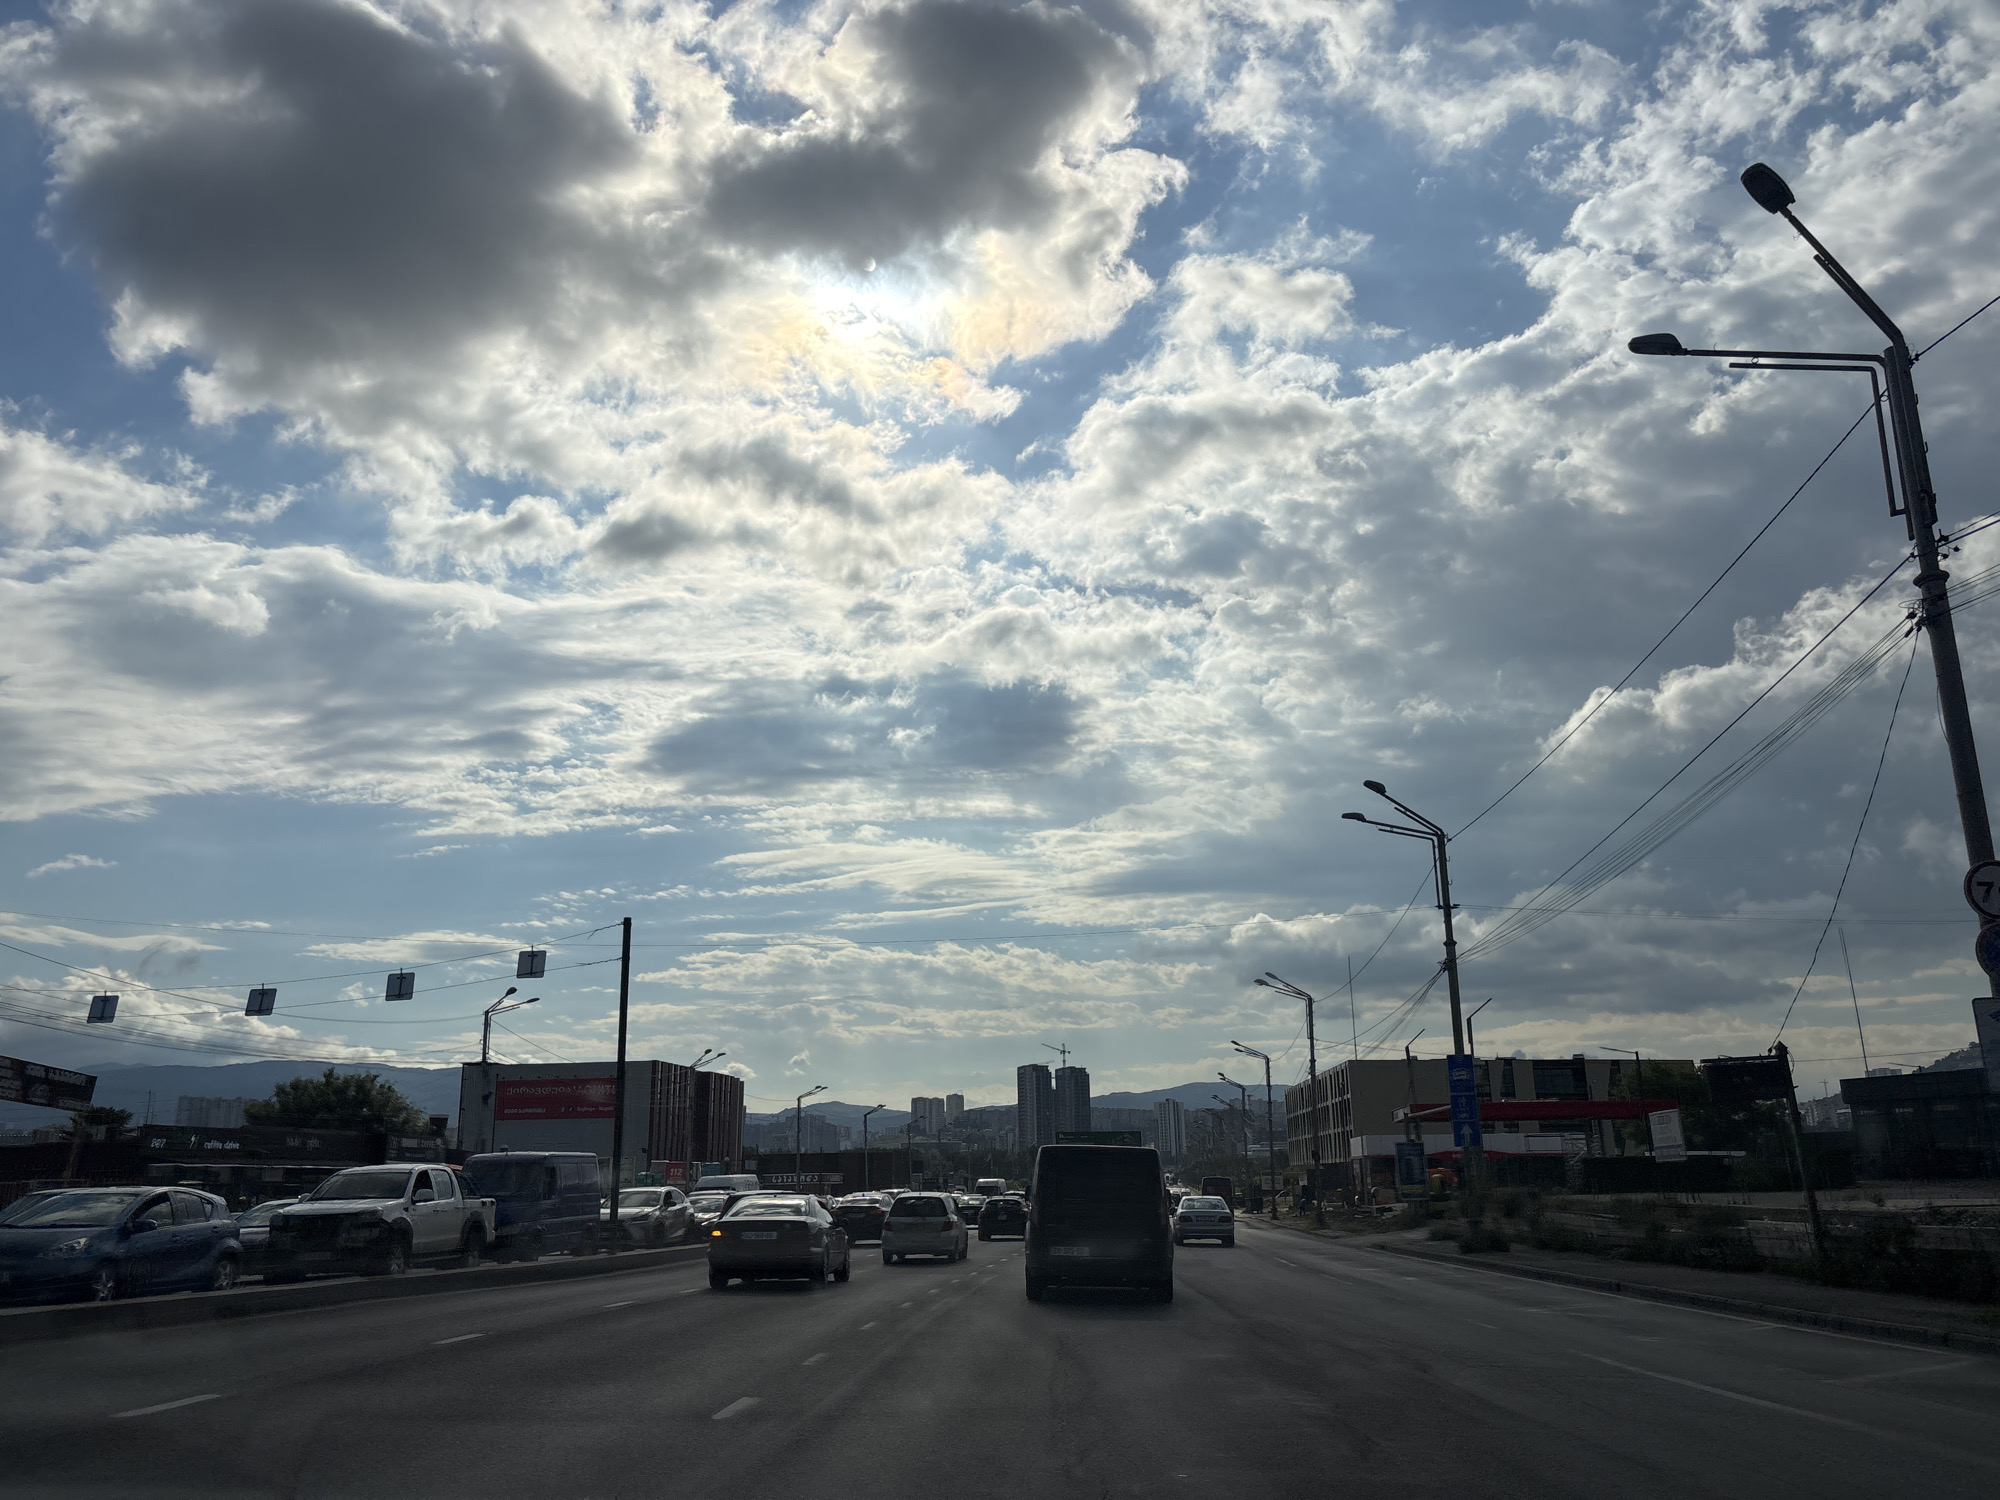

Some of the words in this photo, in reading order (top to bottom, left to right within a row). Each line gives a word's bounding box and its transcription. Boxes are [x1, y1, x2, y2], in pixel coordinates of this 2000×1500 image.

[1976, 881, 2000, 904] 7
[506, 1086, 571, 1096] ქირავდება
[670, 1168, 683, 1176] 112
